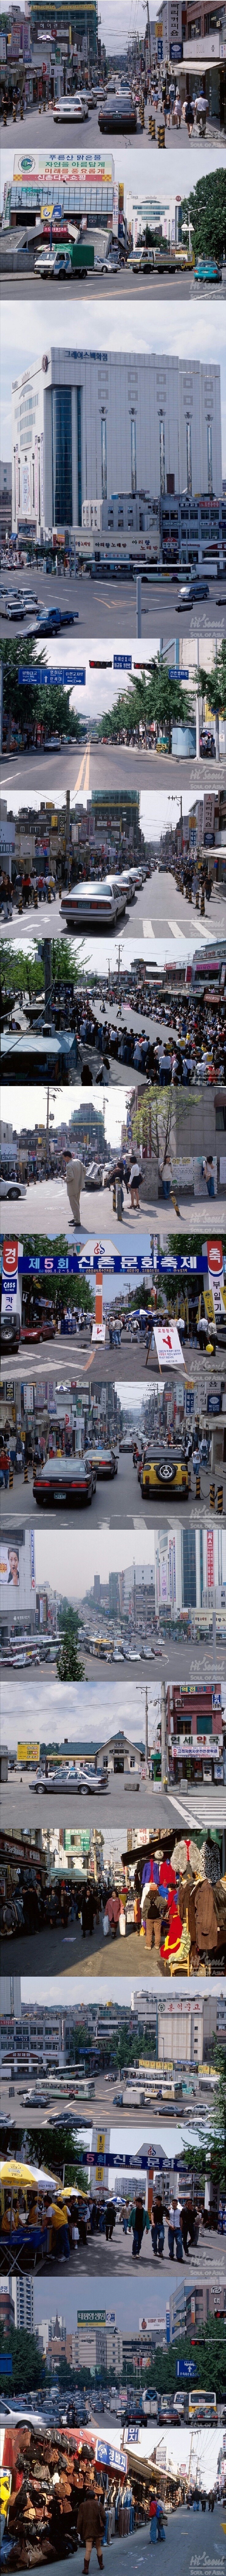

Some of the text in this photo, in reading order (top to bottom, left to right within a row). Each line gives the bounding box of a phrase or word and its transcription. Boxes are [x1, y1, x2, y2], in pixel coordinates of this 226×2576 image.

[170, 4, 179, 36] 빠리커피숍
[65, 351, 107, 361] 그레이스백화점
[5, 1248, 16, 1264] 경
[209, 1248, 220, 1263] 축
[213, 1281, 221, 1311] 부일기
[5, 1297, 13, 1311] 카스
[171, 1736, 220, 1745] 연세약국
[109, 2448, 126, 2467] 청바지
